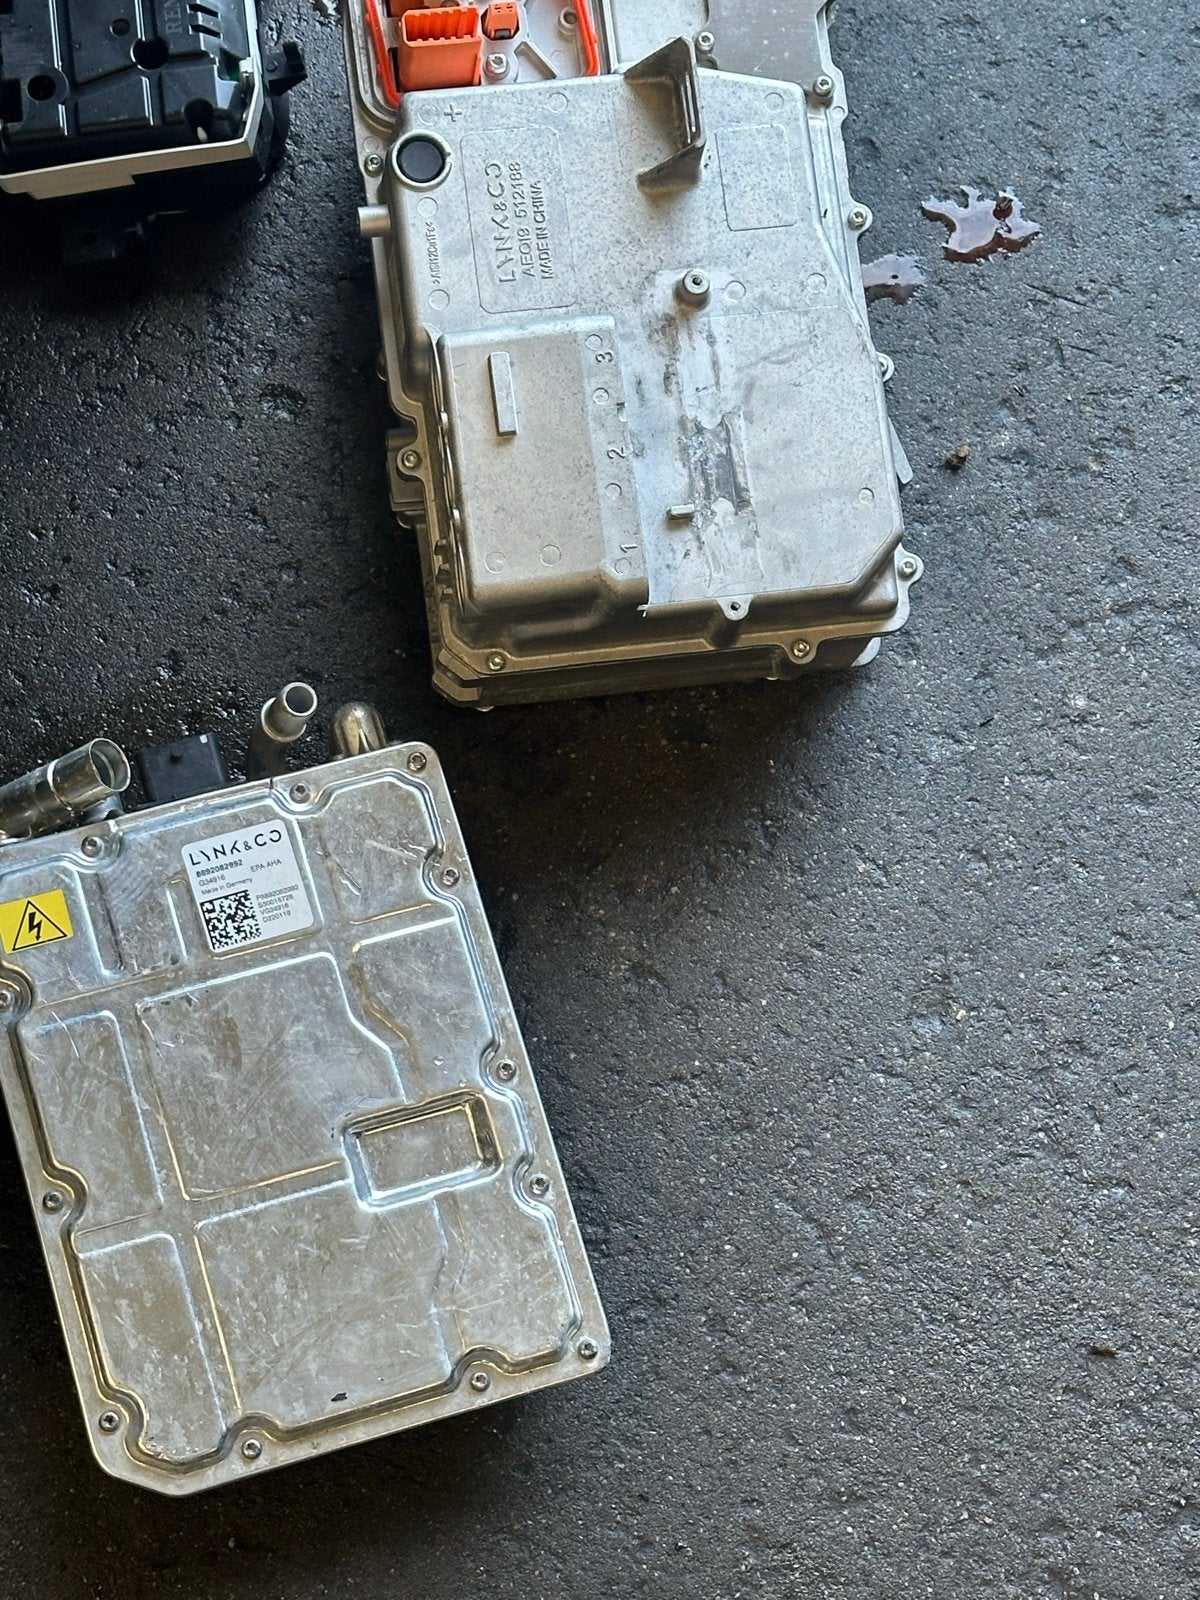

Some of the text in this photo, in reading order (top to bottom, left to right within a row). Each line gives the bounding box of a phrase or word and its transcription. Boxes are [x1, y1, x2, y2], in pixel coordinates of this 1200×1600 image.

[508, 162, 528, 218] 512188
[530, 180, 554, 279] MADE IN CHINA
[595, 351, 614, 363] 3
[607, 447, 626, 459] 2
[620, 543, 638, 553] 1
[226, 877, 253, 889] Germany
